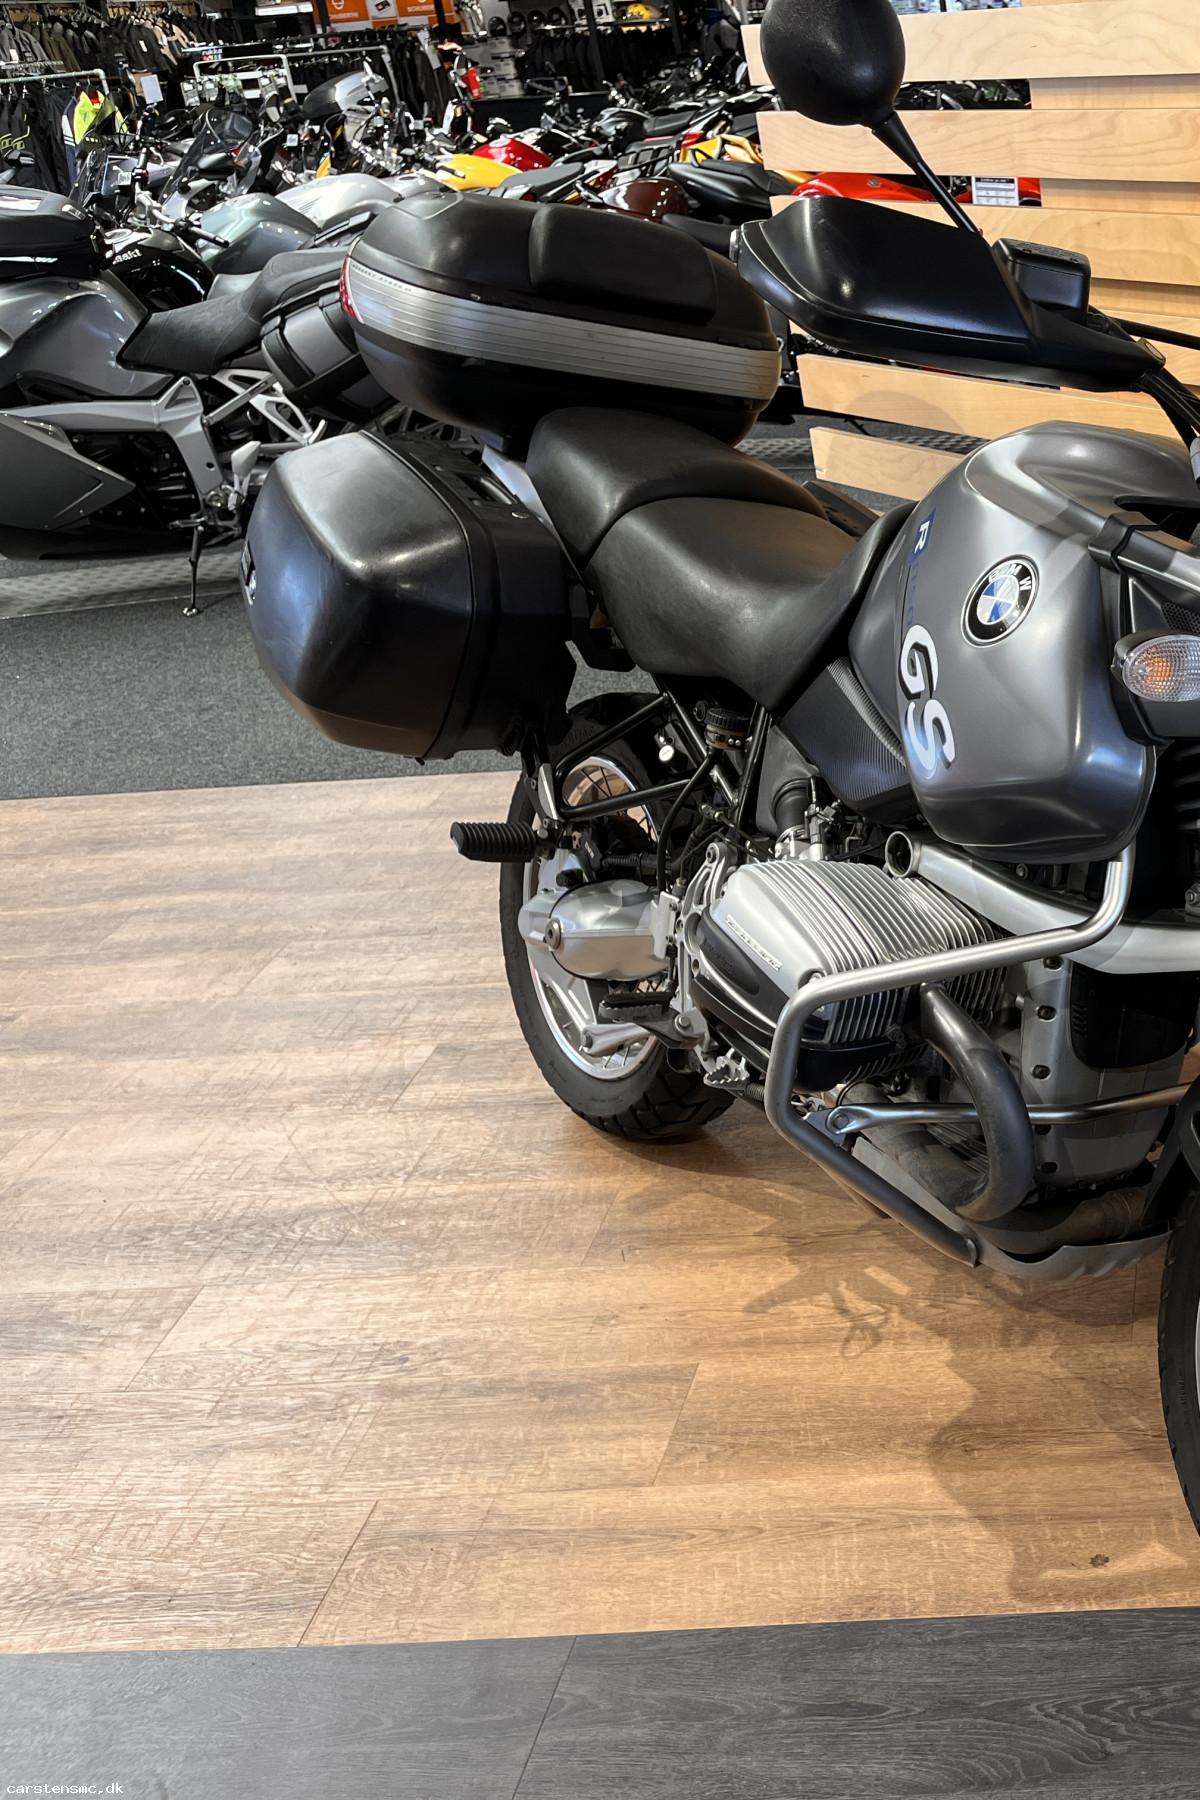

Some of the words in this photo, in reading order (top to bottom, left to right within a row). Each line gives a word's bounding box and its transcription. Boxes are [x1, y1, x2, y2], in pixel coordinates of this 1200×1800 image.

[914, 521, 930, 553] R
[988, 563, 1033, 592] BMW
[899, 624, 956, 778] GS
